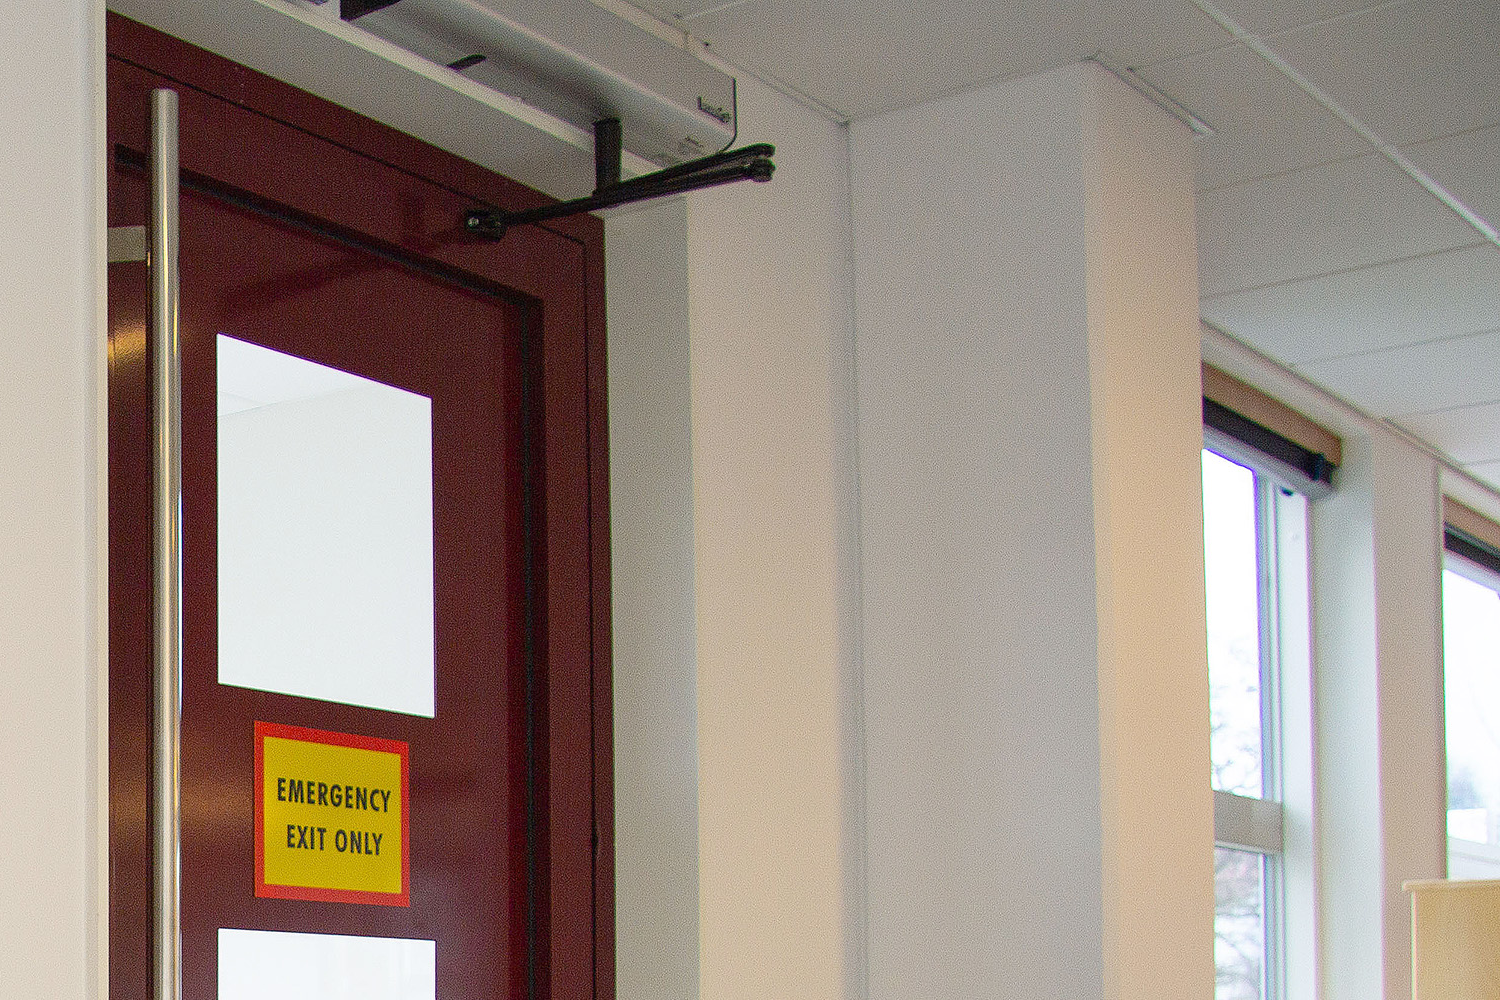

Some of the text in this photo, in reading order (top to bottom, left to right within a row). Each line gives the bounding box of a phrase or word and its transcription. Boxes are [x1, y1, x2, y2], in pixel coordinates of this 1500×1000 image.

[277, 777, 391, 813] EMERGENCY
[287, 824, 383, 855] EXIT ONLY
